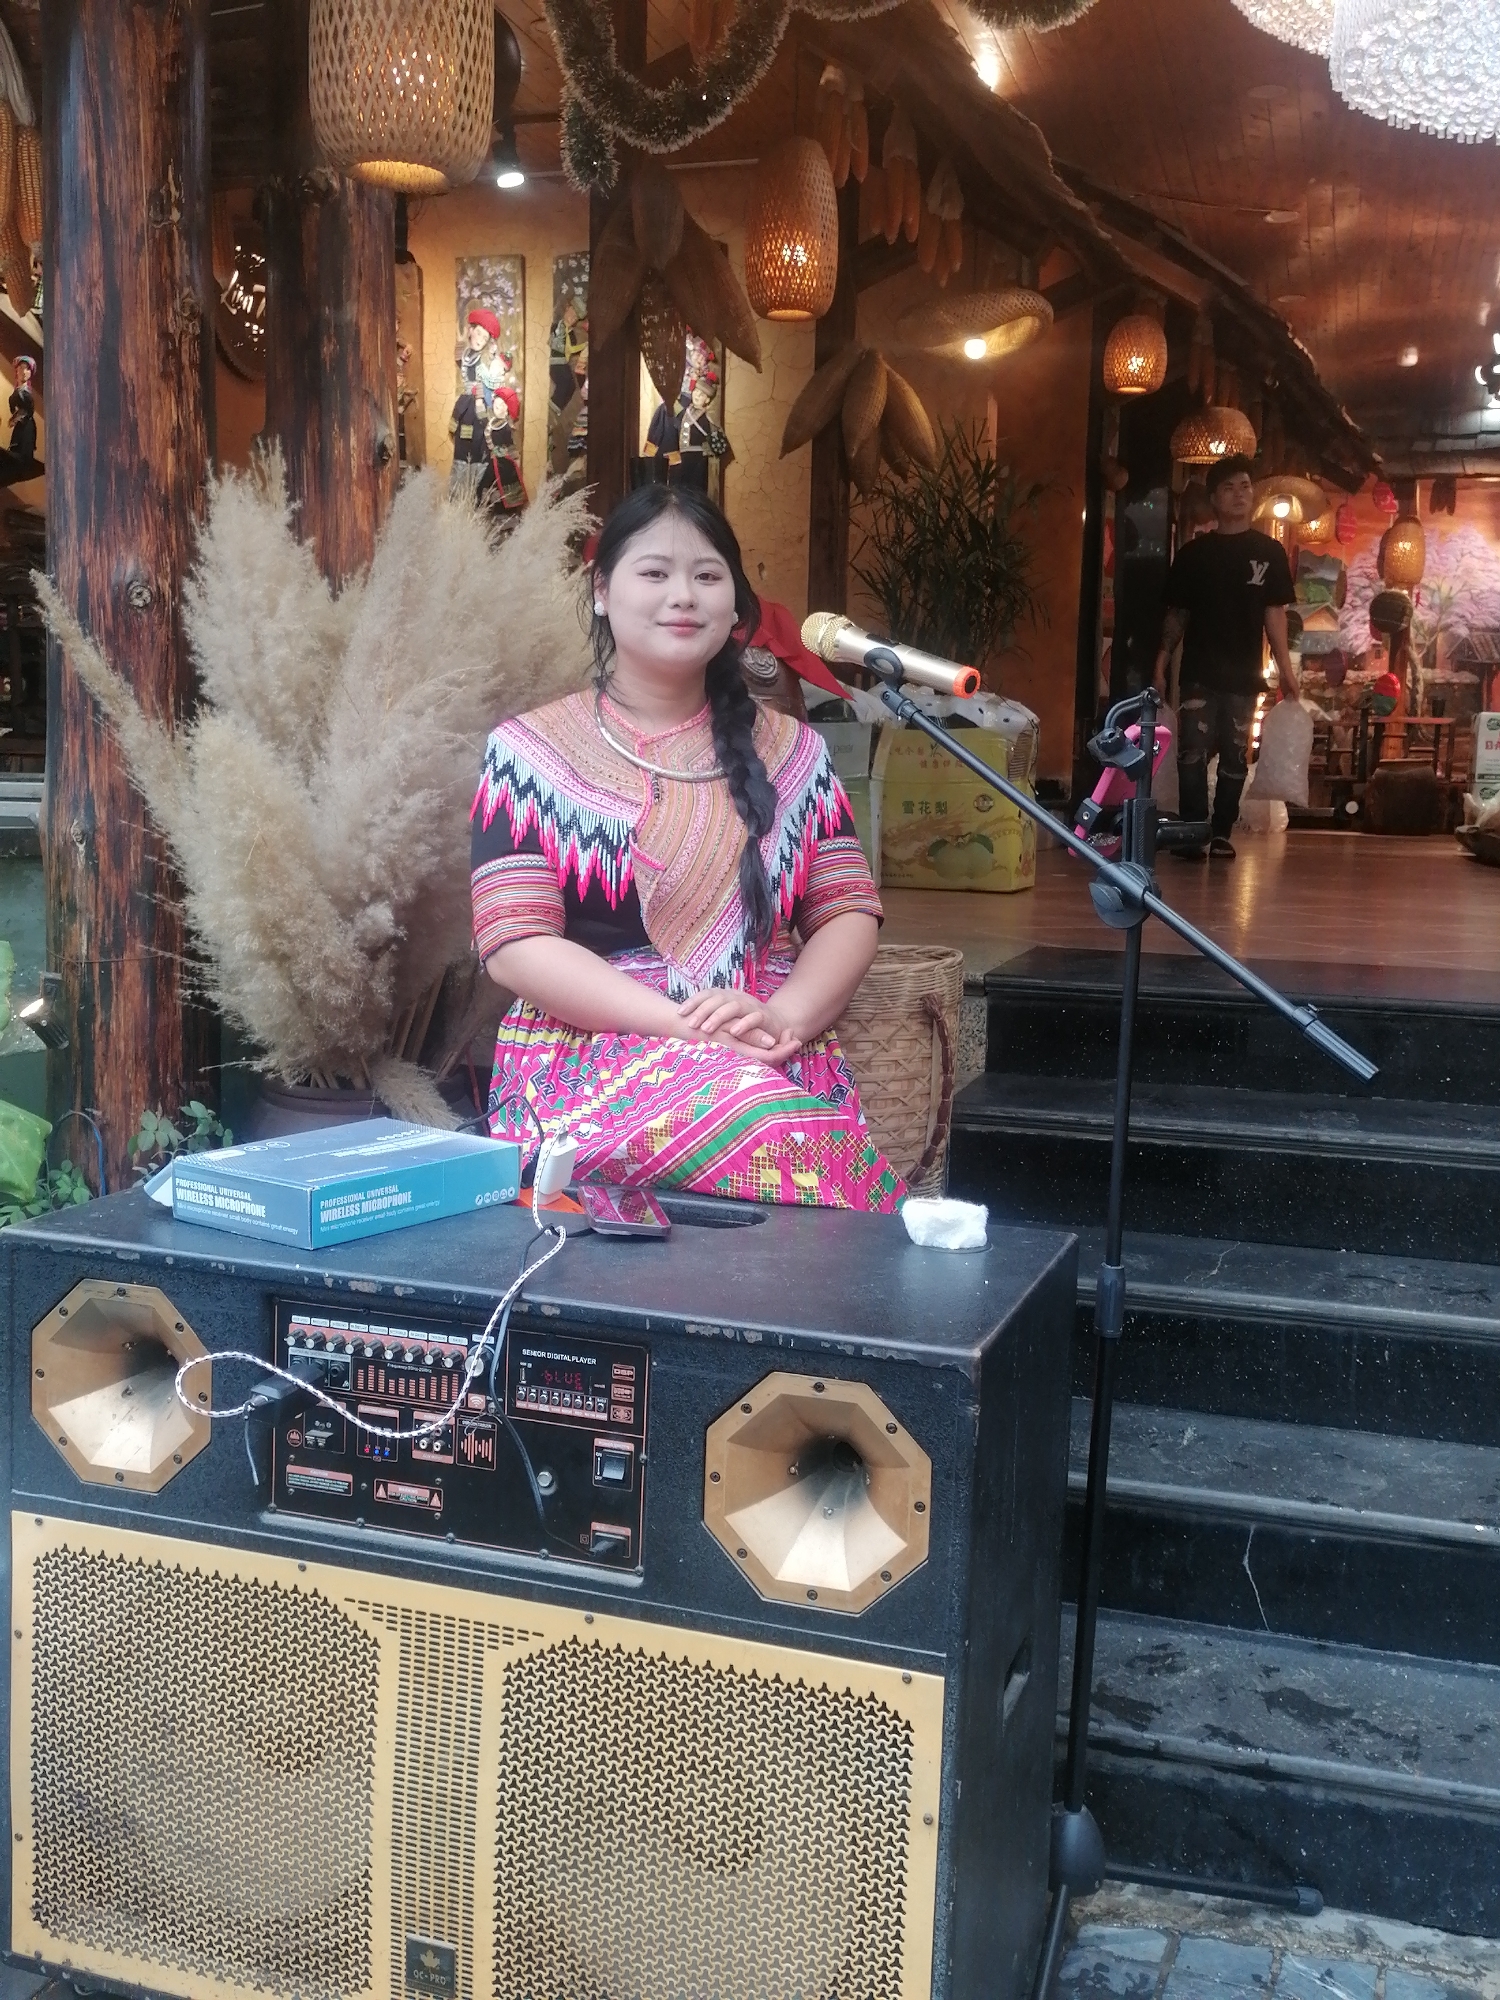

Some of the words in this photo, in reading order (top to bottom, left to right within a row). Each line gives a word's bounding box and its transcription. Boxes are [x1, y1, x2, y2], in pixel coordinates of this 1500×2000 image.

[902, 800, 948, 815] 雪花梨
[176, 1178, 218, 1195] PROFESSIONAL
[220, 1187, 252, 1201] UNIVERSAL
[320, 1193, 365, 1209] PROFESSIONAL
[367, 1184, 399, 1198] UNIVERSAL
[176, 1188, 214, 1207] WIRELESS
[215, 1197, 266, 1217] MICROPHONE
[320, 1204, 360, 1223] WIRELESS
[362, 1191, 411, 1213] MICROPHONE
[522, 1348, 546, 1358] SENIOR
[547, 1352, 571, 1361] DIGITAL
[572, 1355, 597, 1365] PLAYER
[413, 1969, 447, 1985] QC-PRO
